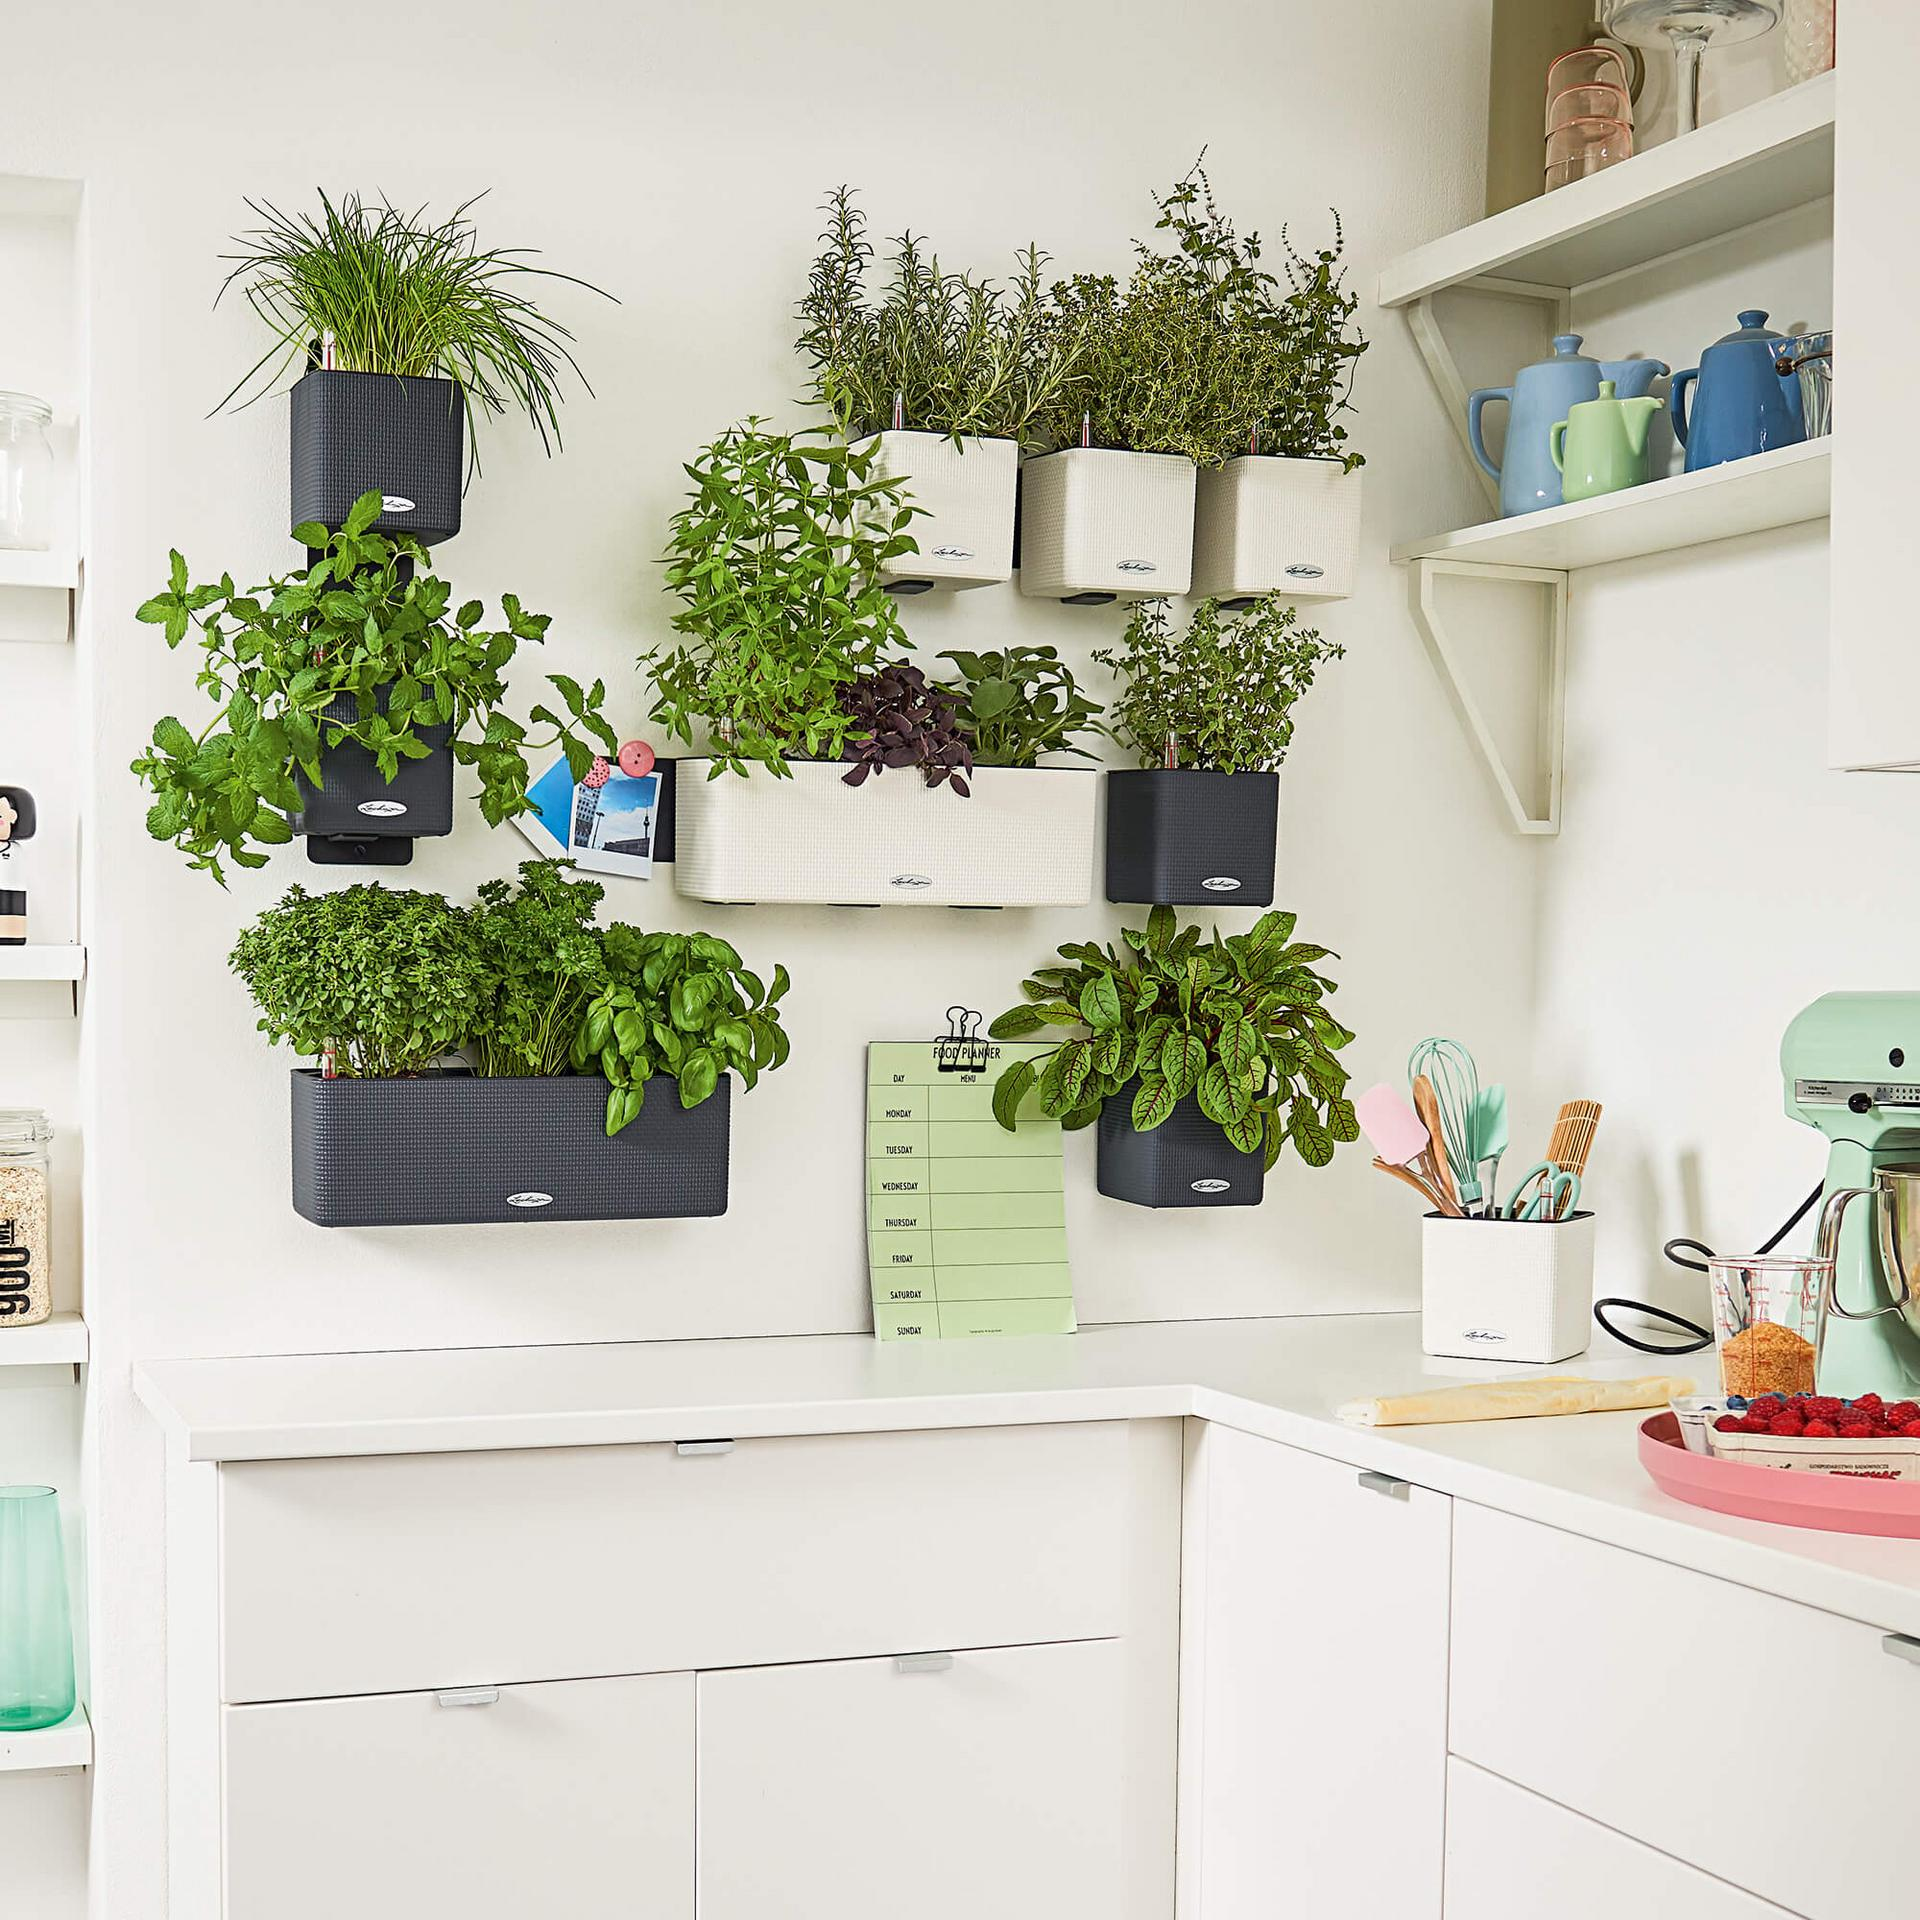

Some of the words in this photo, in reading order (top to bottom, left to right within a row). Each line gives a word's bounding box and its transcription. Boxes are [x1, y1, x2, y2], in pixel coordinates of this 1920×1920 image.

[933, 1047, 958, 1059] FOOD
[962, 1047, 1001, 1059] PLANNER
[893, 1074, 905, 1083] DAY
[960, 1074, 977, 1083] MENU
[886, 1110, 912, 1118] MONDAY
[886, 1146, 913, 1154] TUESDAY
[881, 1182, 919, 1190] WEDNESDAY
[885, 1218, 917, 1227] THURSDAY
[892, 1255, 913, 1263] FRIDAY
[890, 1290, 922, 1299] SATURDAY
[897, 1326, 922, 1335] SUNDAY
